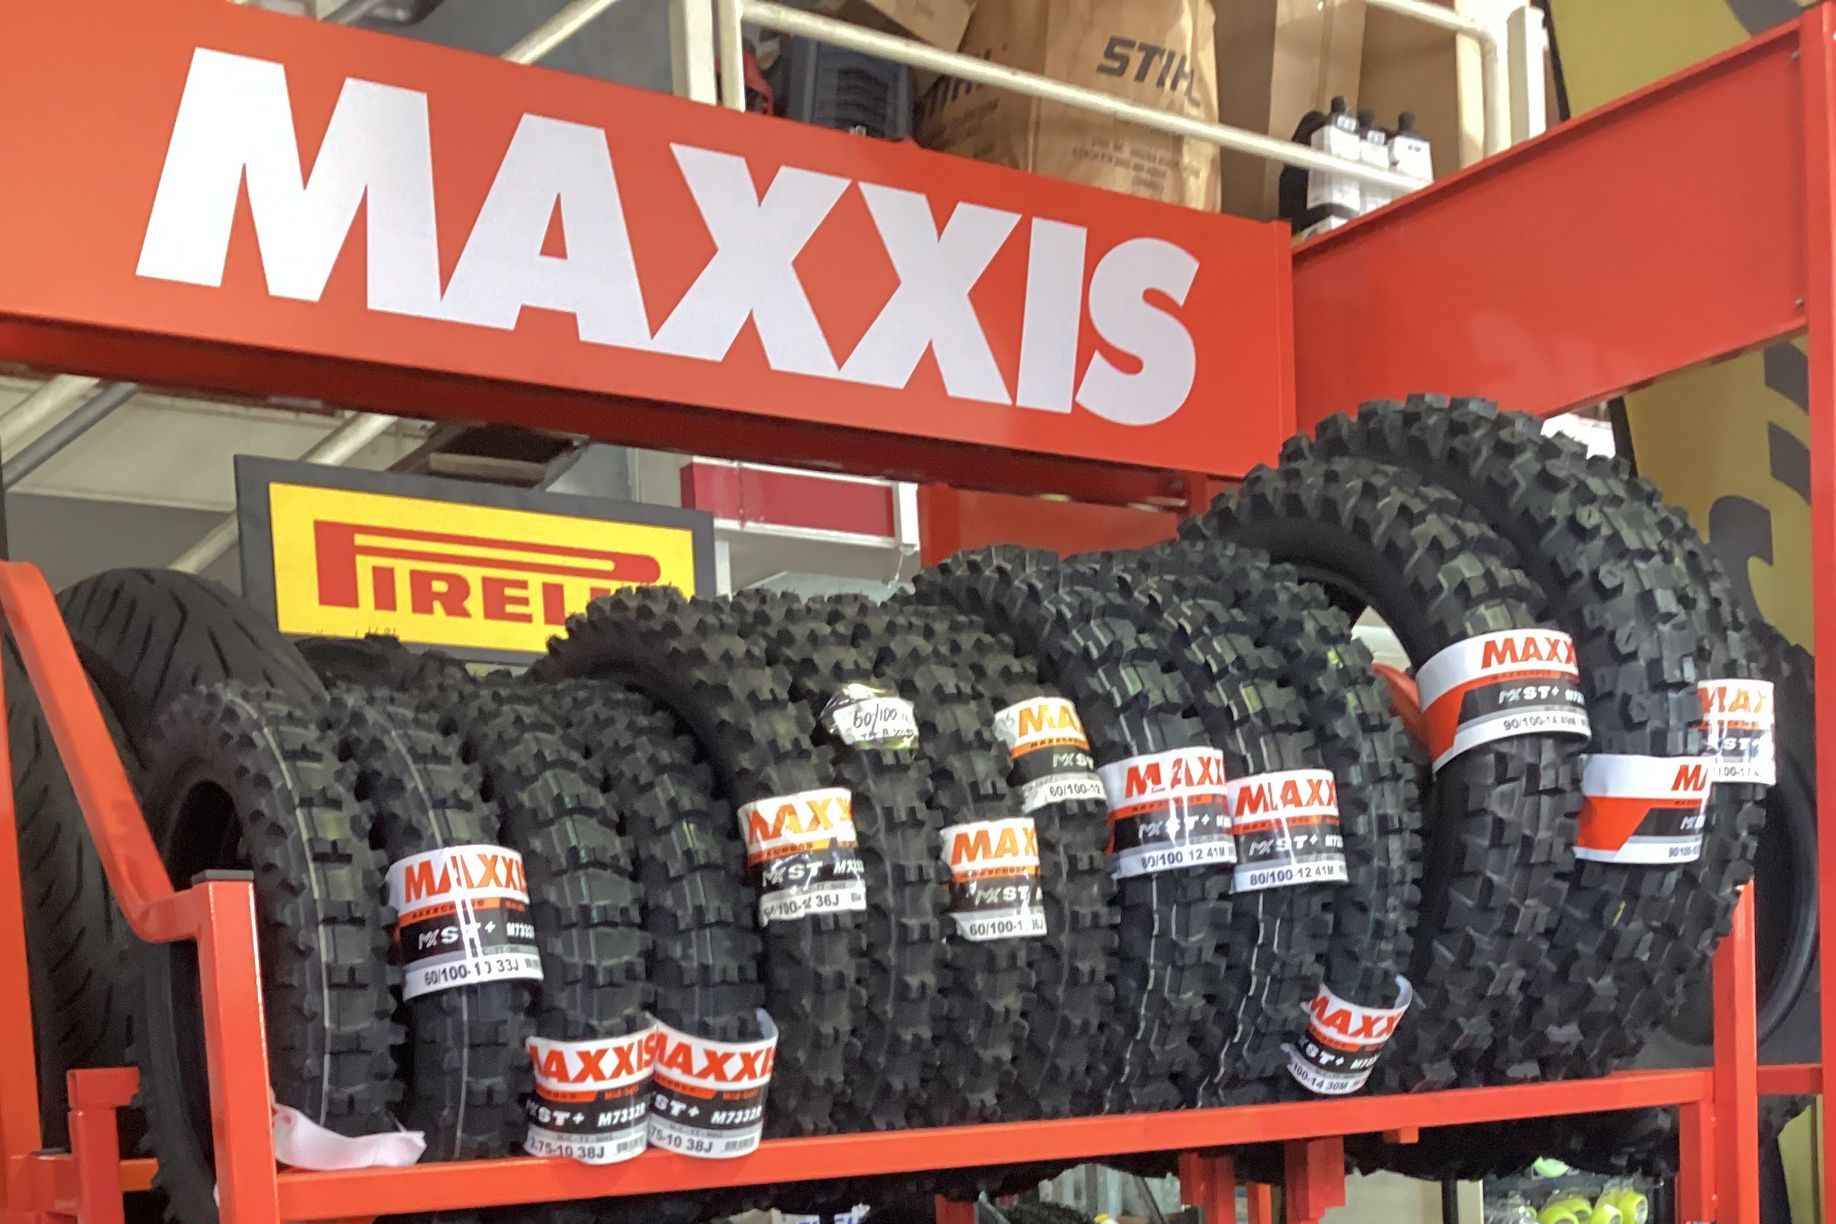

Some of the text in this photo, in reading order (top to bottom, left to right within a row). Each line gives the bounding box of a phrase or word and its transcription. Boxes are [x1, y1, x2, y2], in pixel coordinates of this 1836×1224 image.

[136, 46, 1200, 427] MAXXIS
[313, 520, 661, 627] PIREL
[969, 920, 1023, 937] 60/100-1
[686, 1139, 713, 1153] 38J
